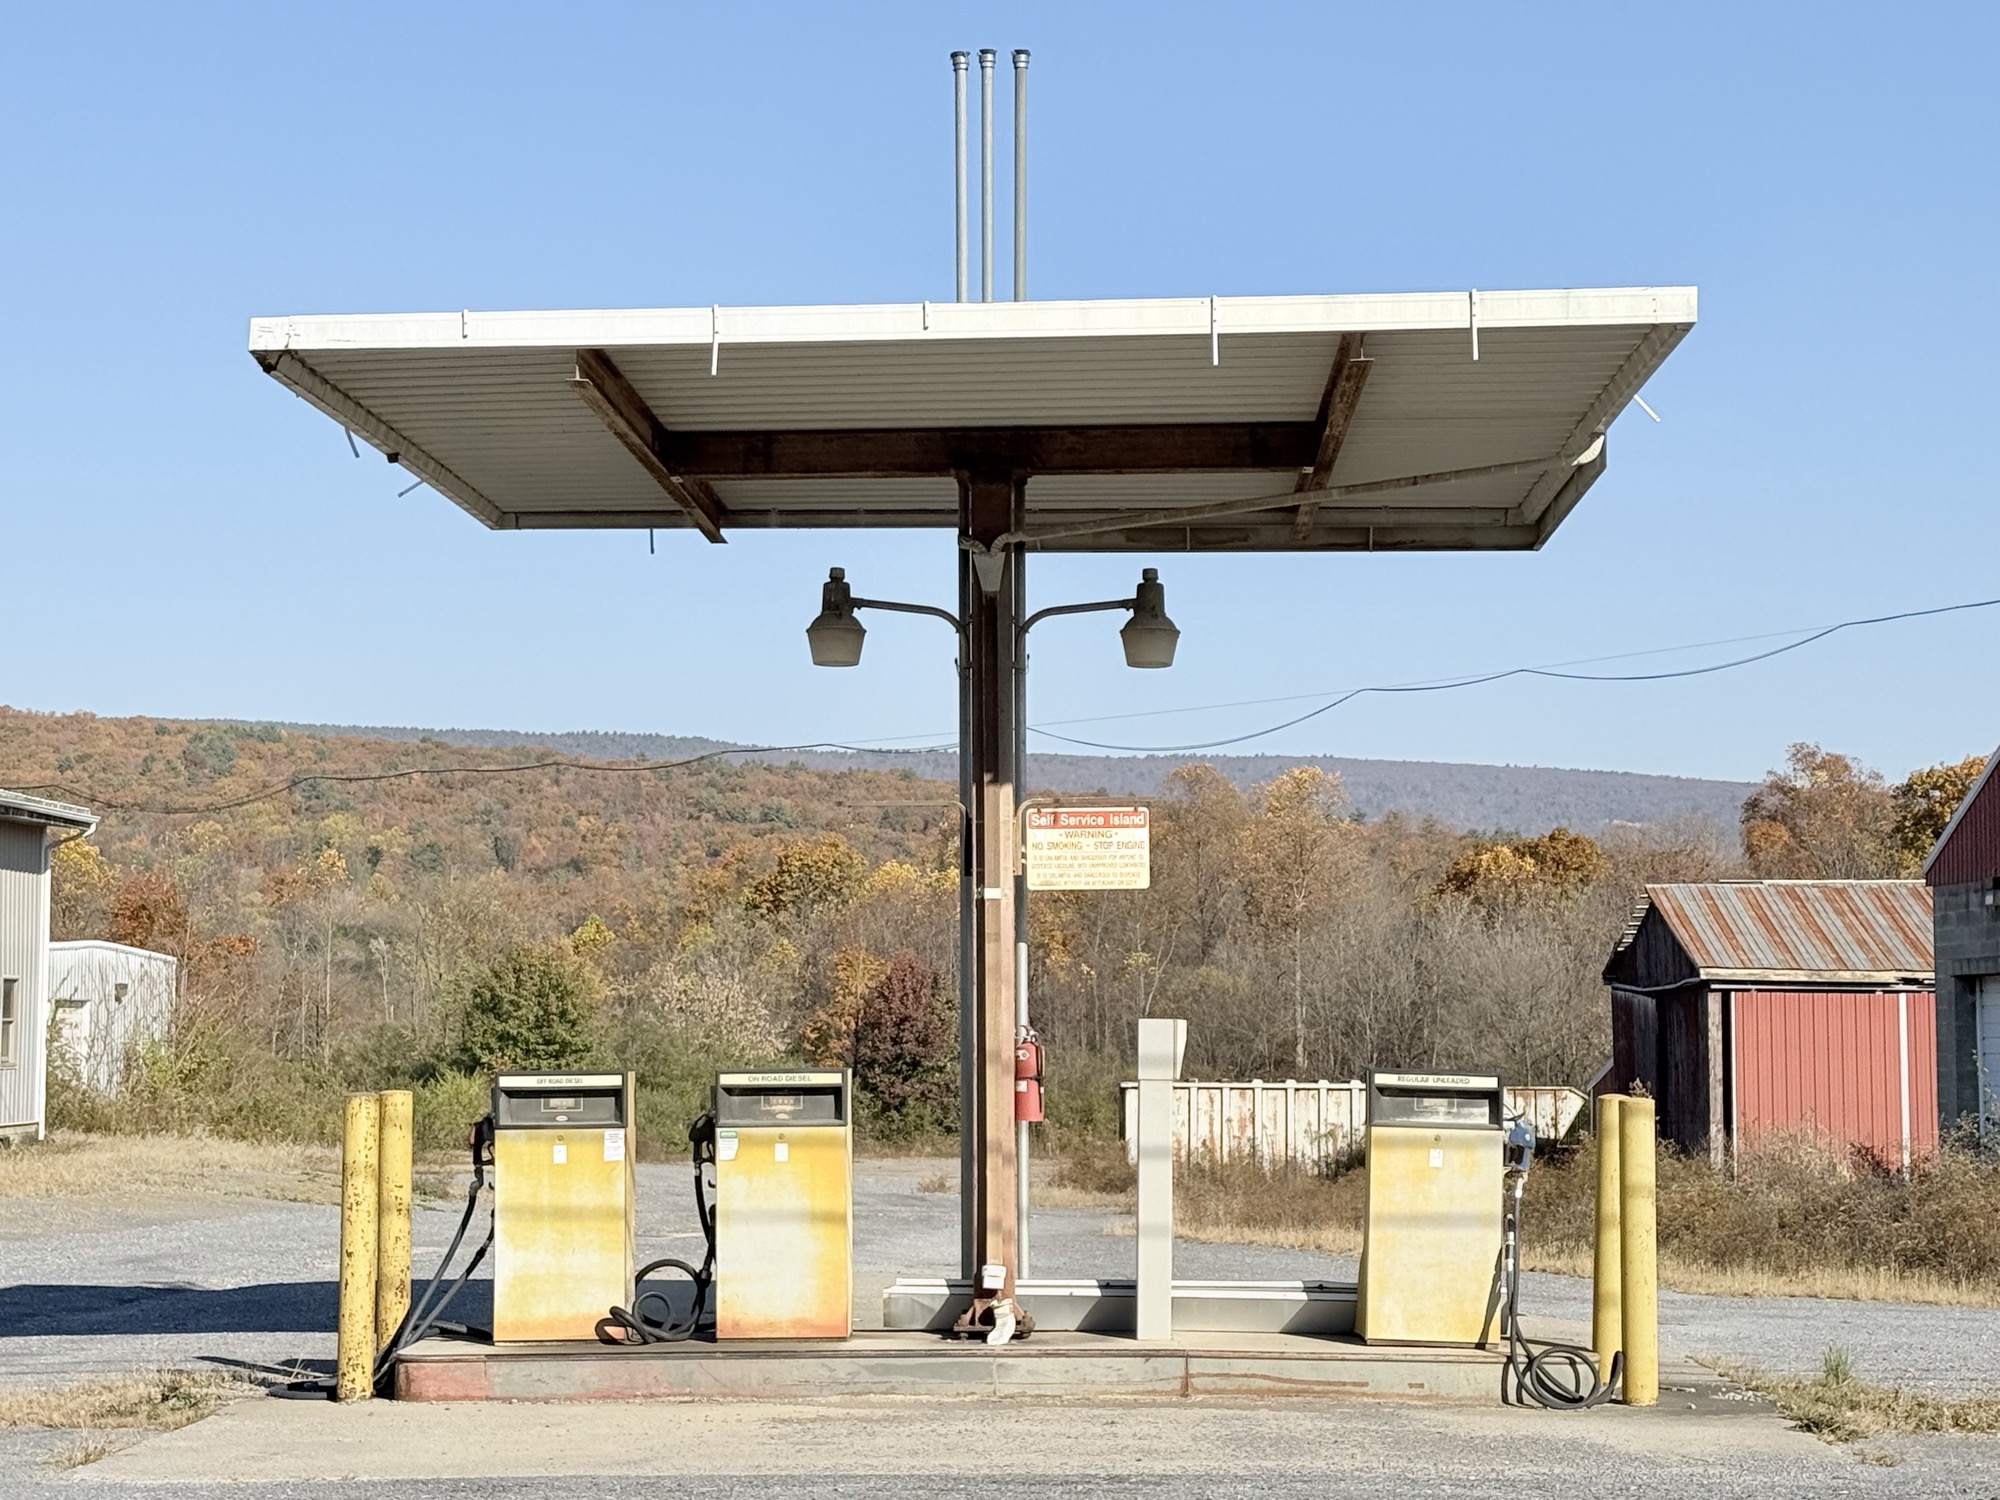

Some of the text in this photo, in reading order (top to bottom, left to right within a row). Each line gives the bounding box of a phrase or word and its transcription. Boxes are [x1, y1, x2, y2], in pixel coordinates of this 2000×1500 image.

[1060, 813, 1104, 826] Service
[1110, 813, 1144, 825] Island
[1065, 830, 1113, 839] WARNING
[1032, 841, 1145, 850] NO SMOKING STOP ENGINE
[1397, 1075, 1470, 1085] REGULAR UNLEADED
